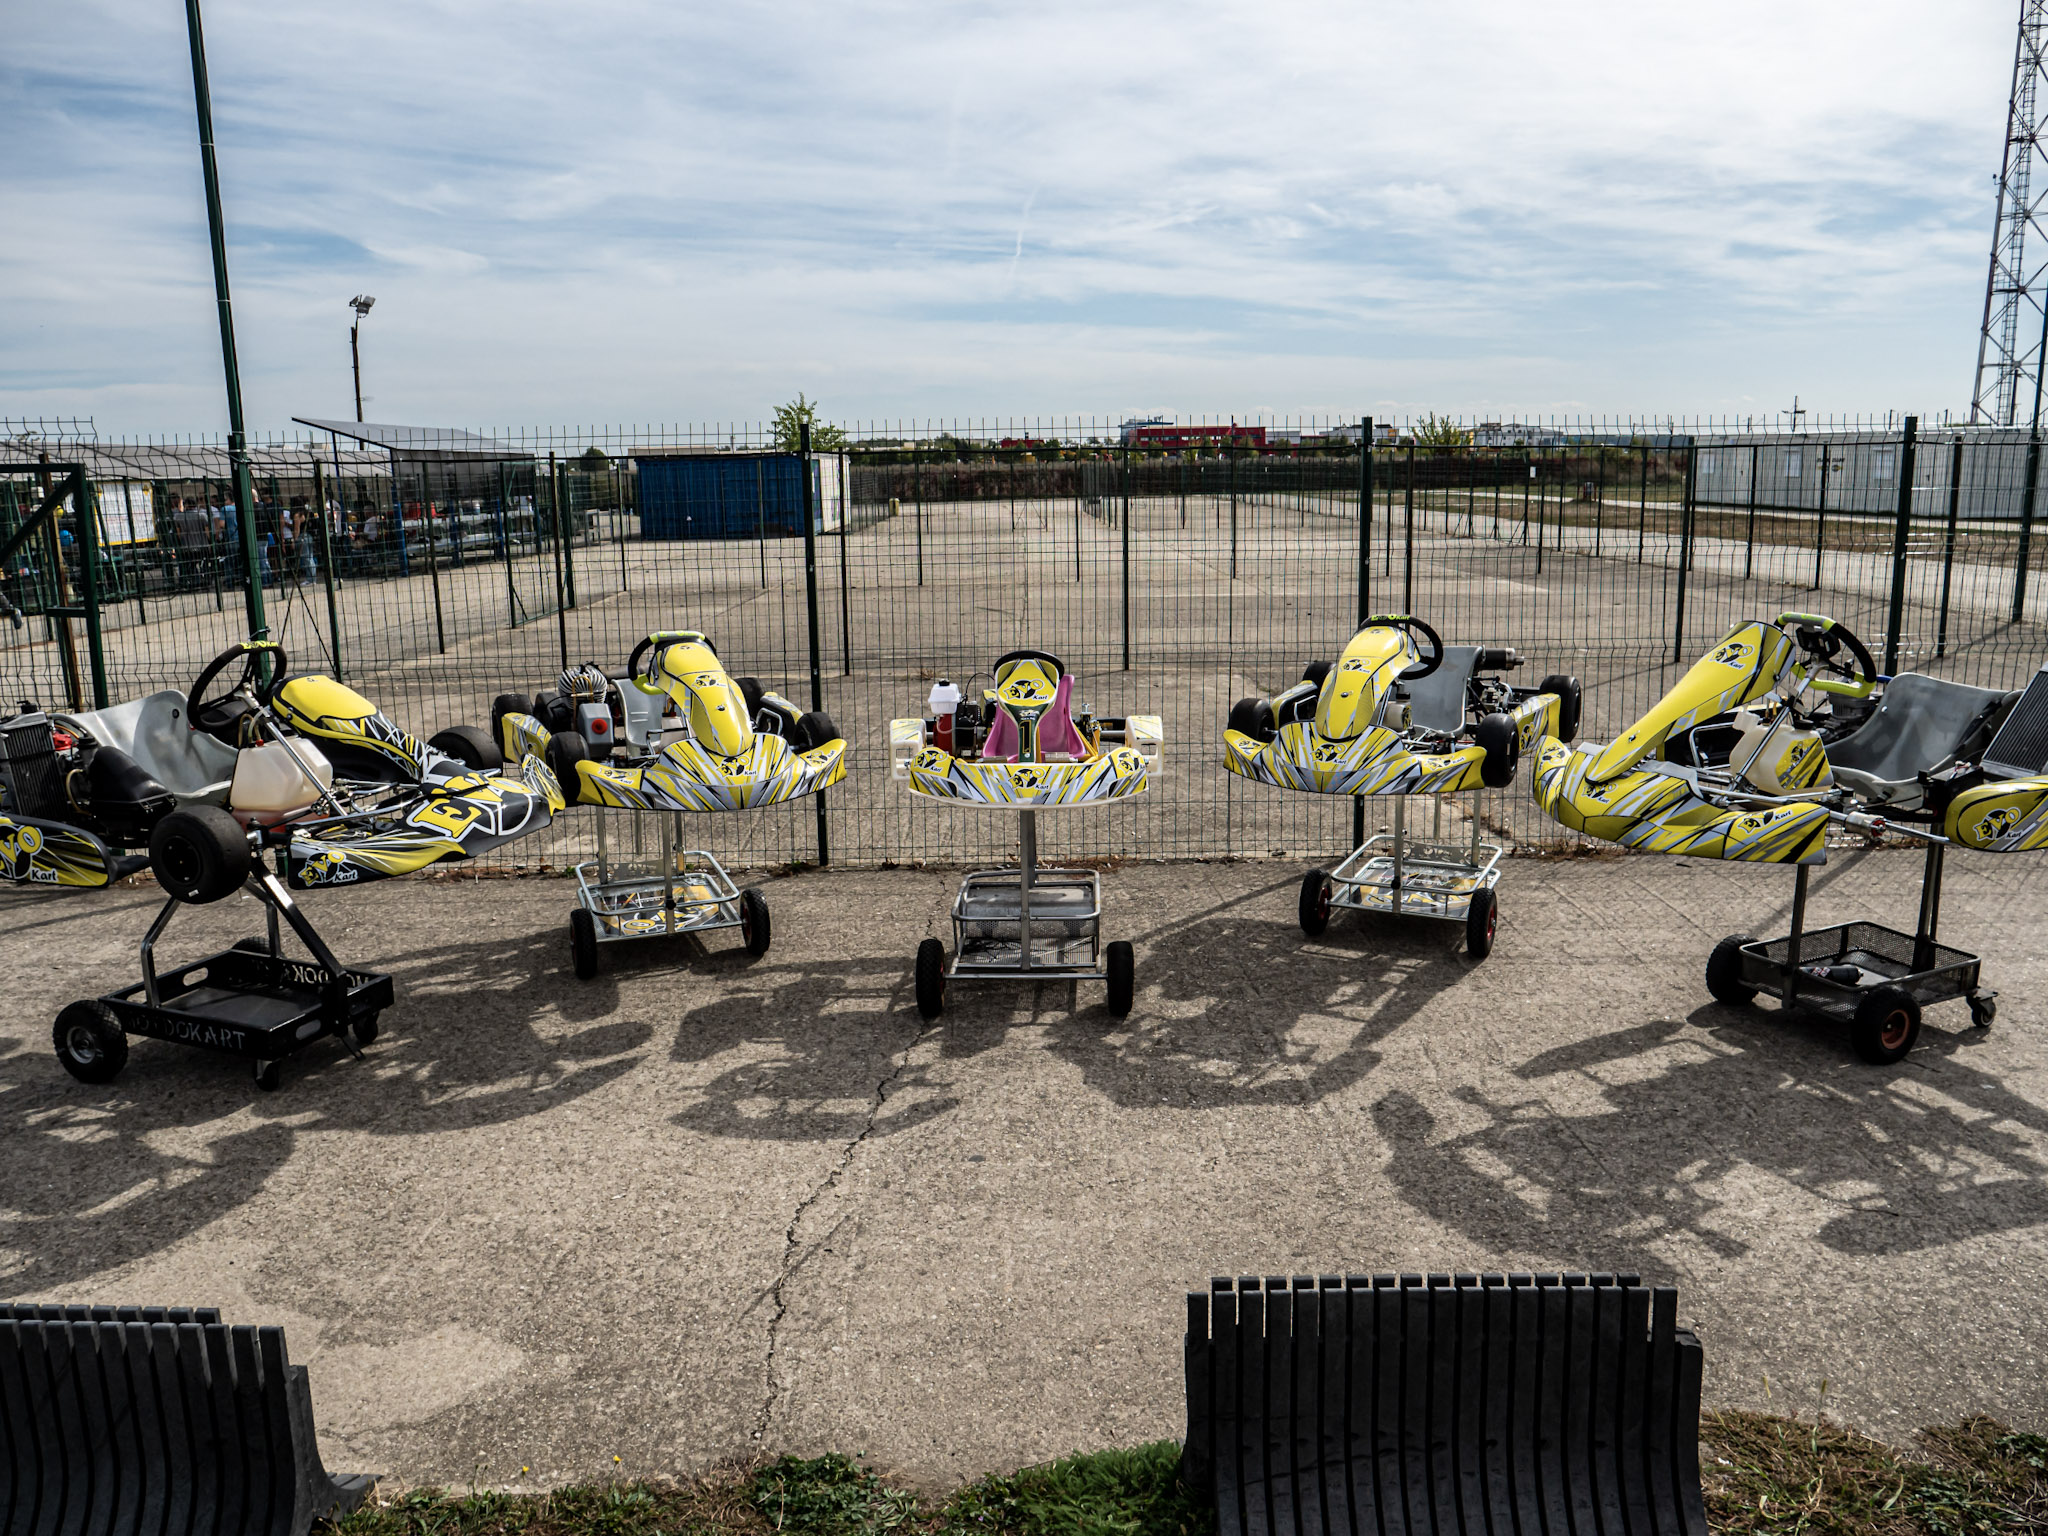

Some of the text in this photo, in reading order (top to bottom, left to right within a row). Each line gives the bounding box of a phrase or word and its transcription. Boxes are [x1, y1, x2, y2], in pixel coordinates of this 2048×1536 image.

[1709, 645, 1754, 661] EVO
[1004, 680, 1044, 699] EVO
[1019, 719, 1032, 754] 1
[914, 752, 948, 767] EVO
[1310, 743, 1347, 761] EVO
[716, 756, 750, 777] EVO
[1008, 768, 1046, 789] EVO
[1582, 783, 1617, 797] EVO
[413, 772, 534, 839] EVO
[1775, 811, 1791, 820] Kart
[1974, 808, 2020, 839] EVO
[0, 825, 57, 881] VO Kart
[300, 852, 356, 885] EVO Kart
